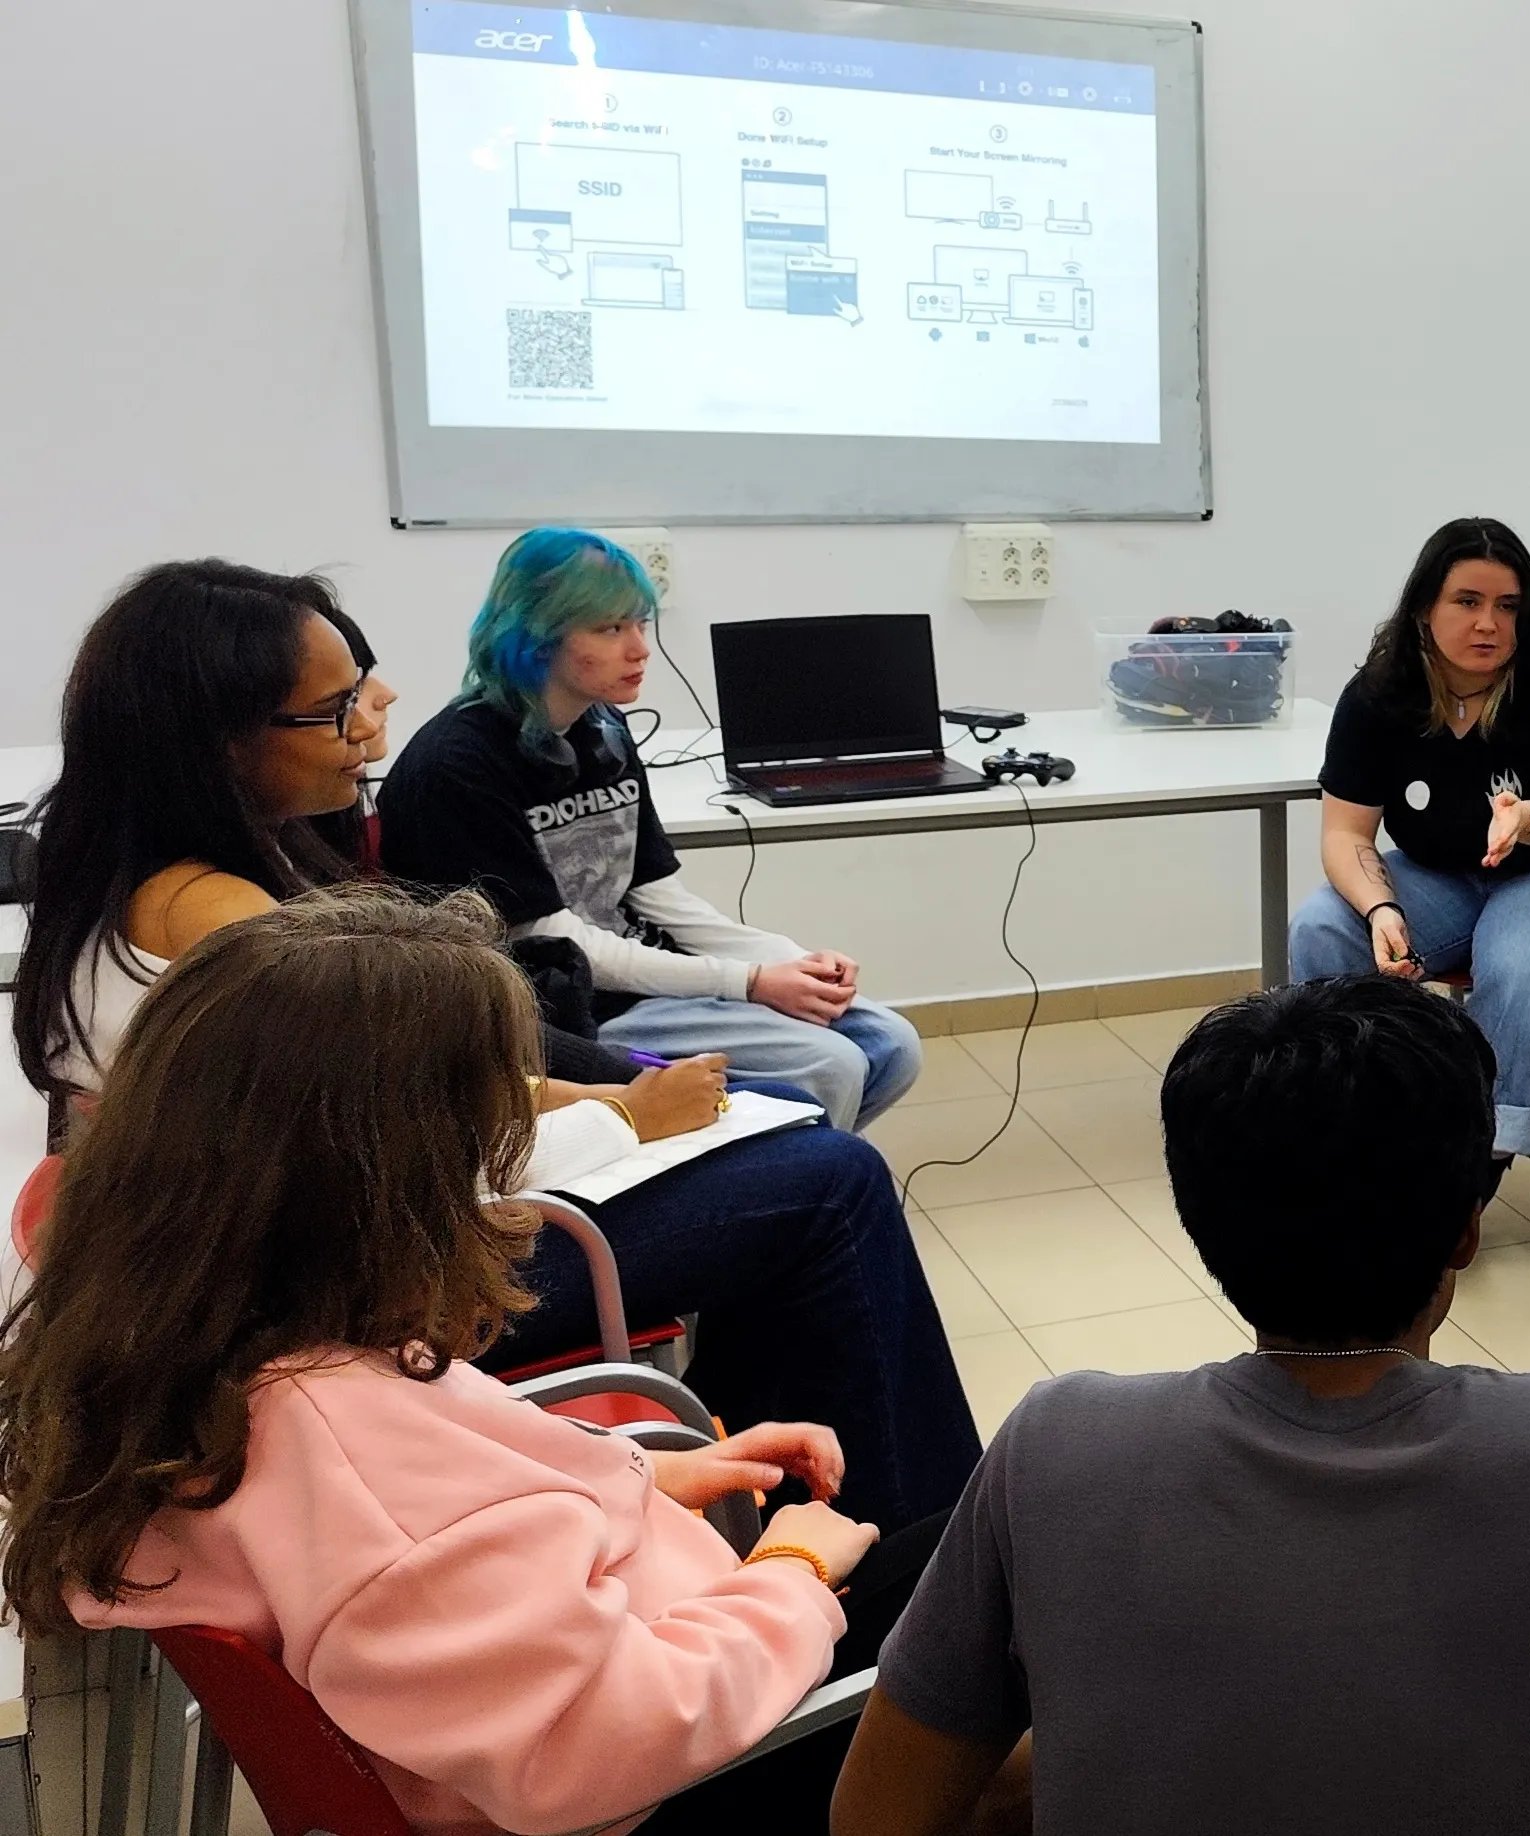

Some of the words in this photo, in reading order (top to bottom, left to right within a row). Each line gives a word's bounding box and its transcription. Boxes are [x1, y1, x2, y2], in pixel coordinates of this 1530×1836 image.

[474, 28, 553, 53] acer
[737, 131, 766, 143] Done
[929, 145, 955, 158] Start
[957, 147, 981, 160] Your
[983, 150, 1019, 161] Screen
[1021, 153, 1067, 168] Mirroring
[577, 179, 623, 198] SSID
